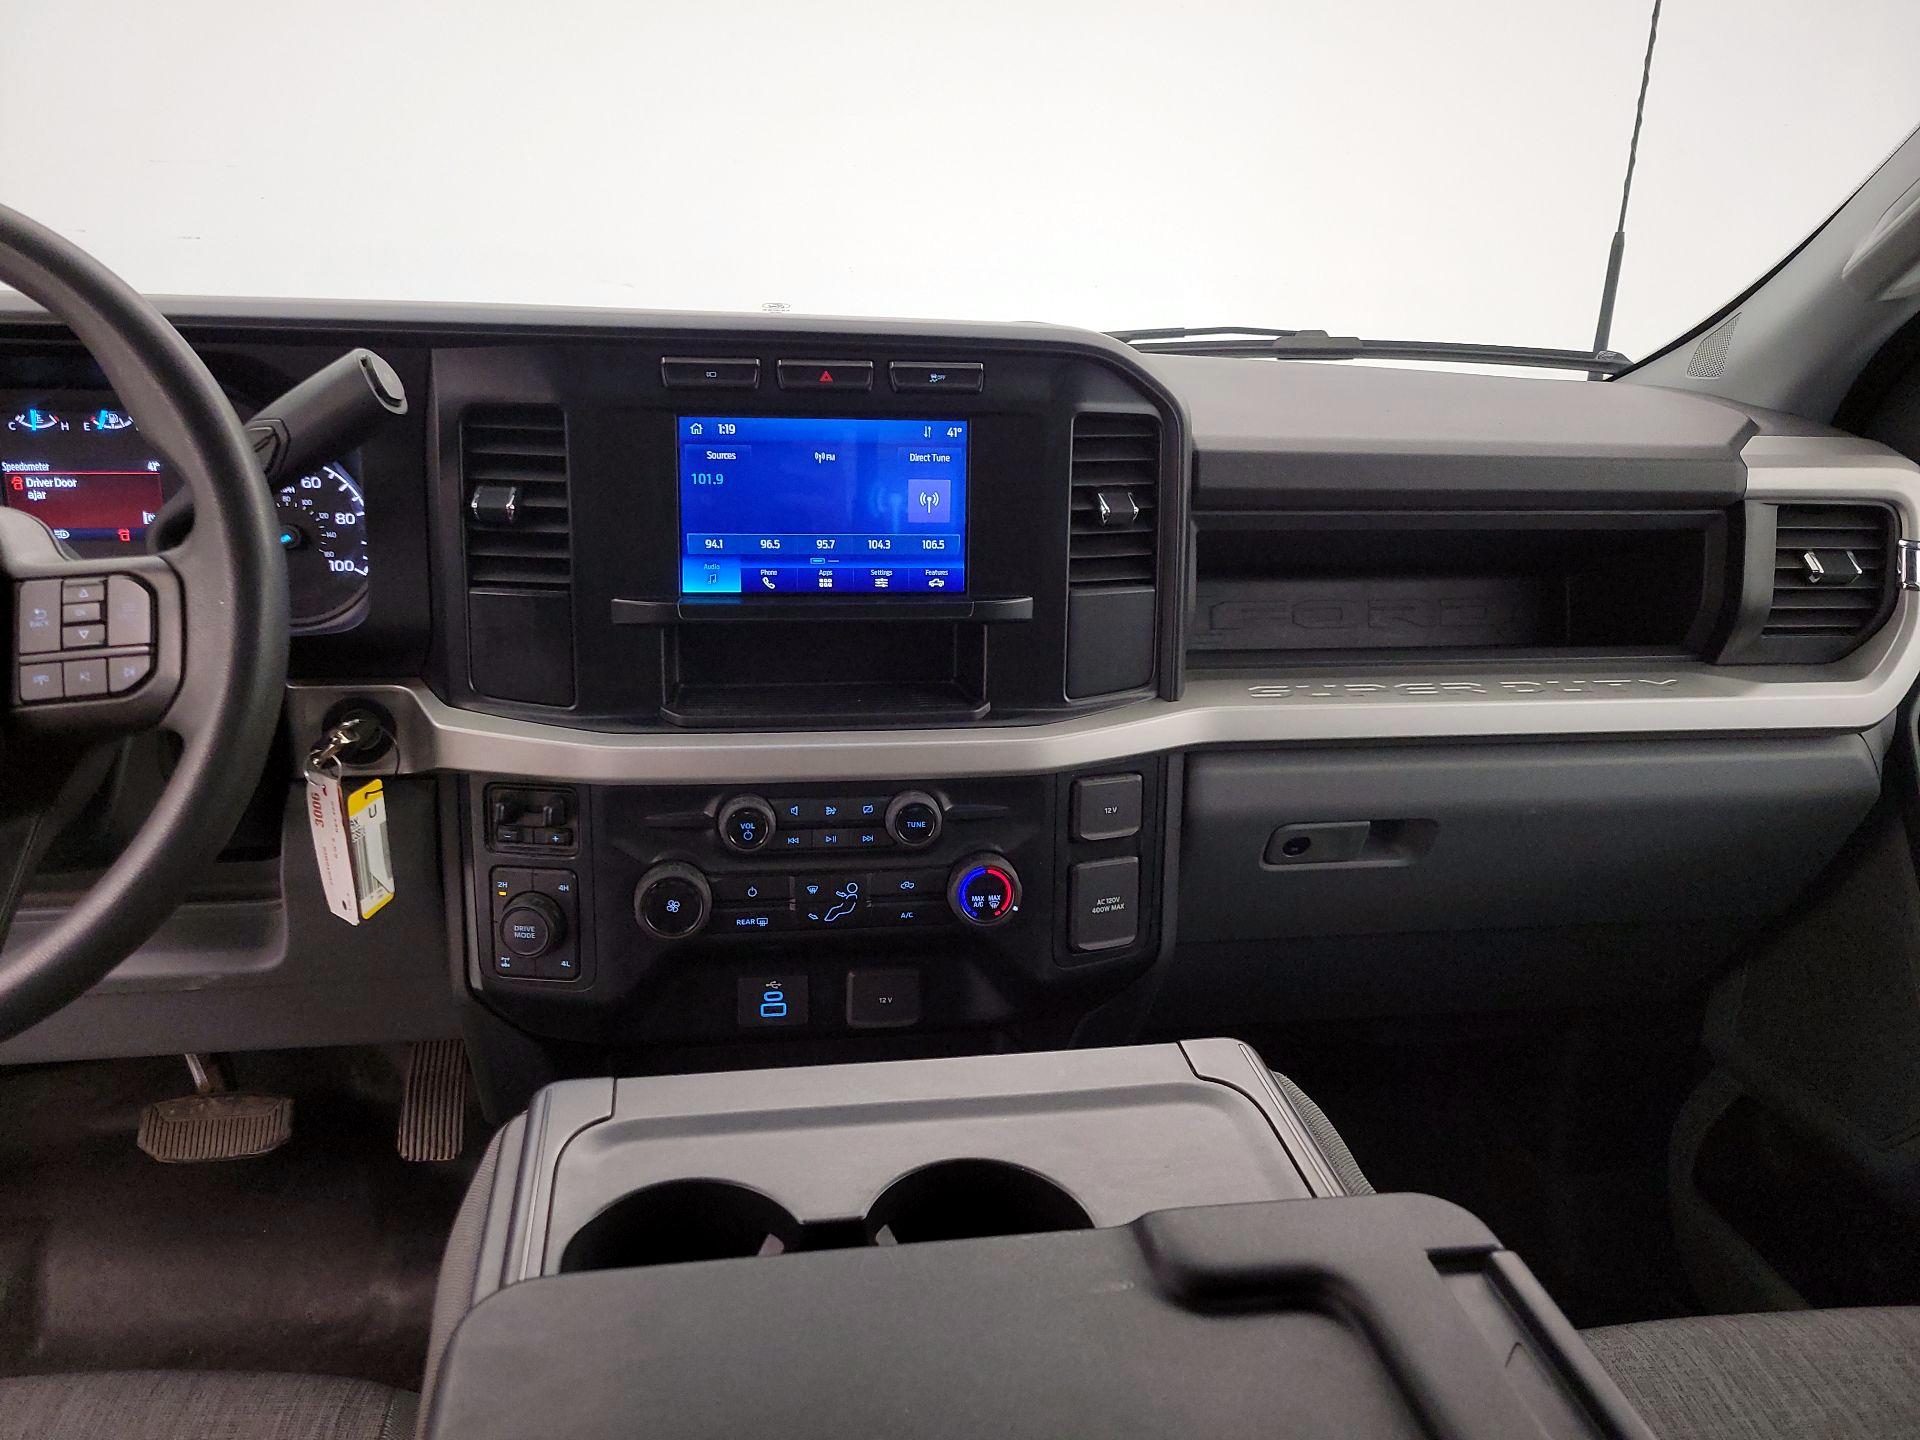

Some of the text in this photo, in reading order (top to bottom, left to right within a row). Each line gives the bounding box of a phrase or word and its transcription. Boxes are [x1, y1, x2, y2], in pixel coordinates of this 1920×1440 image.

[8, 422, 16, 431] C
[61, 422, 70, 431] H
[84, 422, 91, 431] E
[718, 424, 736, 435] 1:19
[947, 427, 963, 437] 41°
[706, 450, 737, 460] Sources
[826, 452, 836, 461] FM
[909, 453, 951, 463] Direct Tune
[2, 461, 50, 473] Speedometer
[26, 477, 78, 488] Driver Door
[300, 476, 321, 489] 60
[691, 473, 724, 485] 101.9
[28, 490, 47, 501] ajar
[335, 513, 356, 525] 80
[705, 539, 724, 549] 94.1
[760, 539, 781, 550] 96.5
[816, 539, 835, 550] 95.7
[868, 540, 891, 550] 104.3
[922, 540, 945, 550] 106.5
[328, 560, 354, 572] 100
[703, 563, 720, 571] Audio
[760, 569, 778, 577] Phone
[818, 569, 833, 577] Apps
[870, 569, 893, 577] Settings
[925, 569, 948, 577] Features
[1247, 679, 1678, 699] SUPER DUTY
[312, 792, 325, 828] 3006
[1104, 807, 1112, 815] 12
[740, 822, 756, 830] VOL
[906, 820, 926, 829] TUNE
[558, 884, 569, 892] 4H
[1097, 896, 1121, 906] AC 120V
[1092, 903, 1125, 914] 400W MAX
